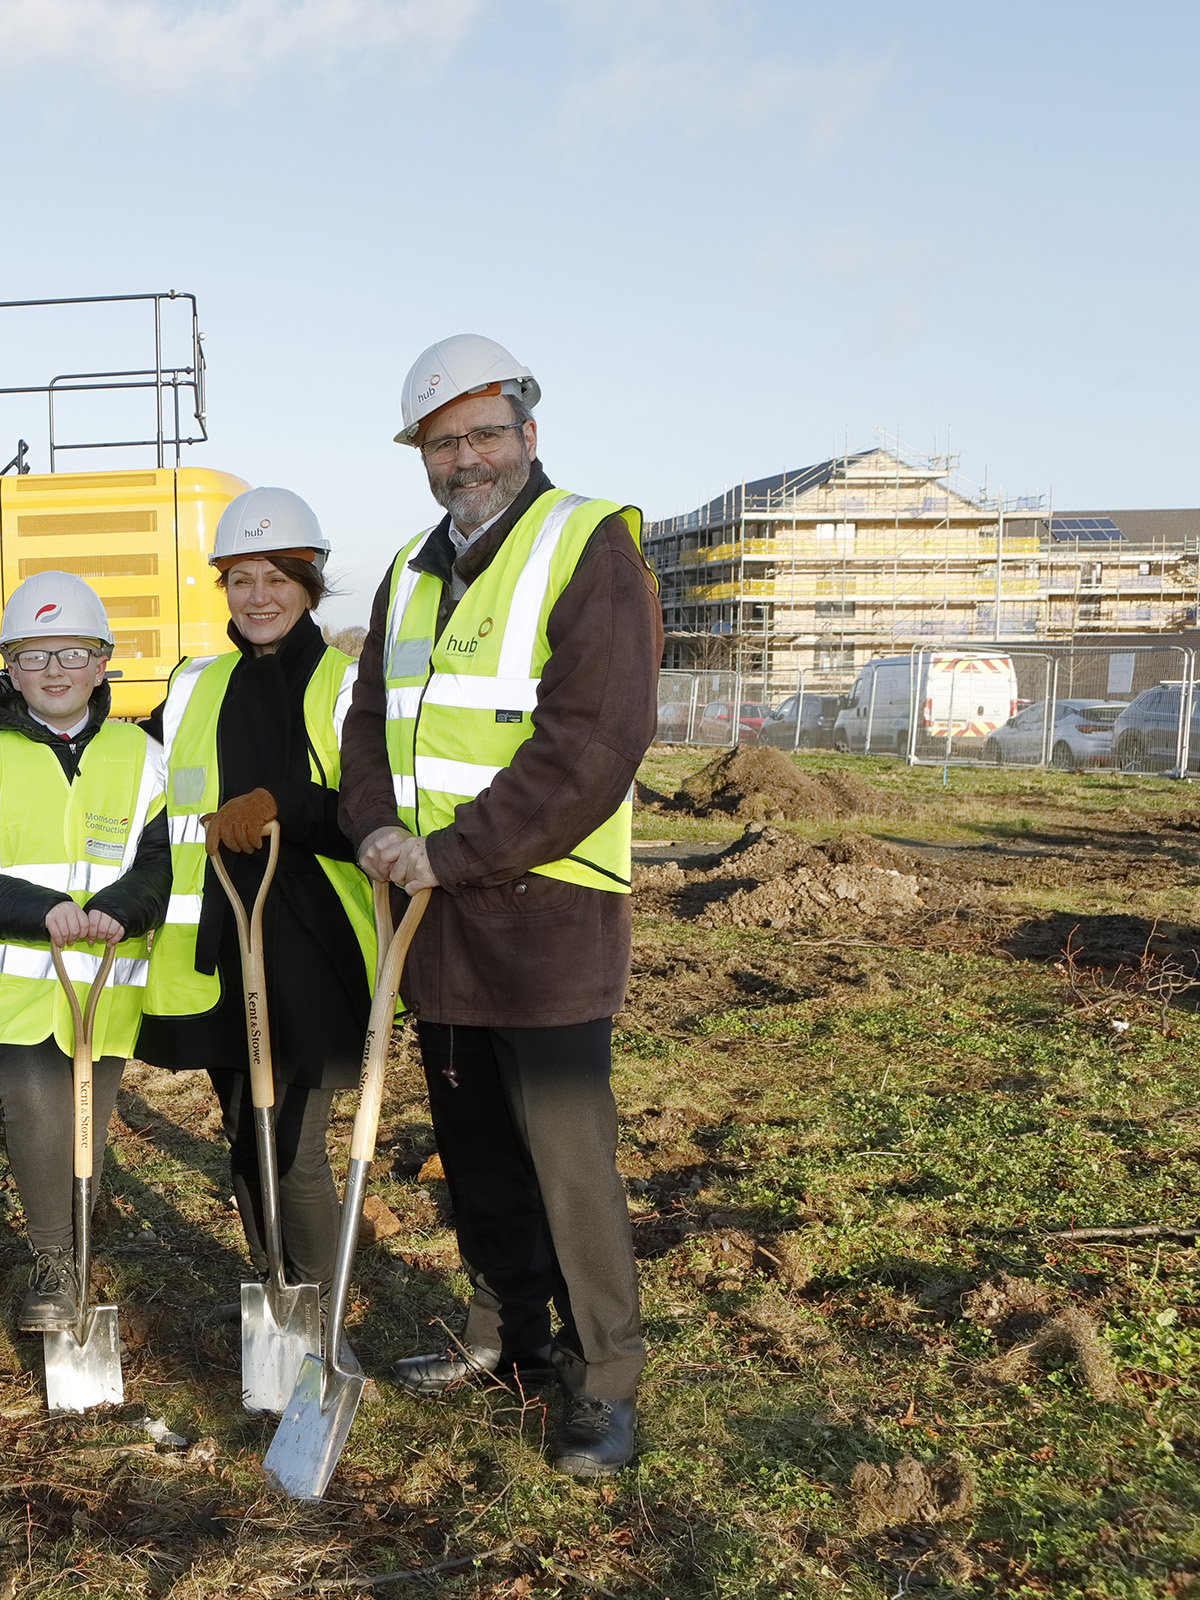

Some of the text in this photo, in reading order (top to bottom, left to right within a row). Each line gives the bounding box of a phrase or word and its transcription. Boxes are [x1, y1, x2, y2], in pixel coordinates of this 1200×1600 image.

[417, 387, 436, 404] hub
[244, 527, 264, 538] hub
[446, 634, 479, 654] hub
[85, 811, 119, 826] Morrison
[248, 992, 259, 1020] Kent
[251, 1029, 262, 1065] Stowe
[362, 1030, 376, 1061] Kent
[80, 1081, 91, 1106] Kent
[80, 1115, 91, 1149] Stowe
